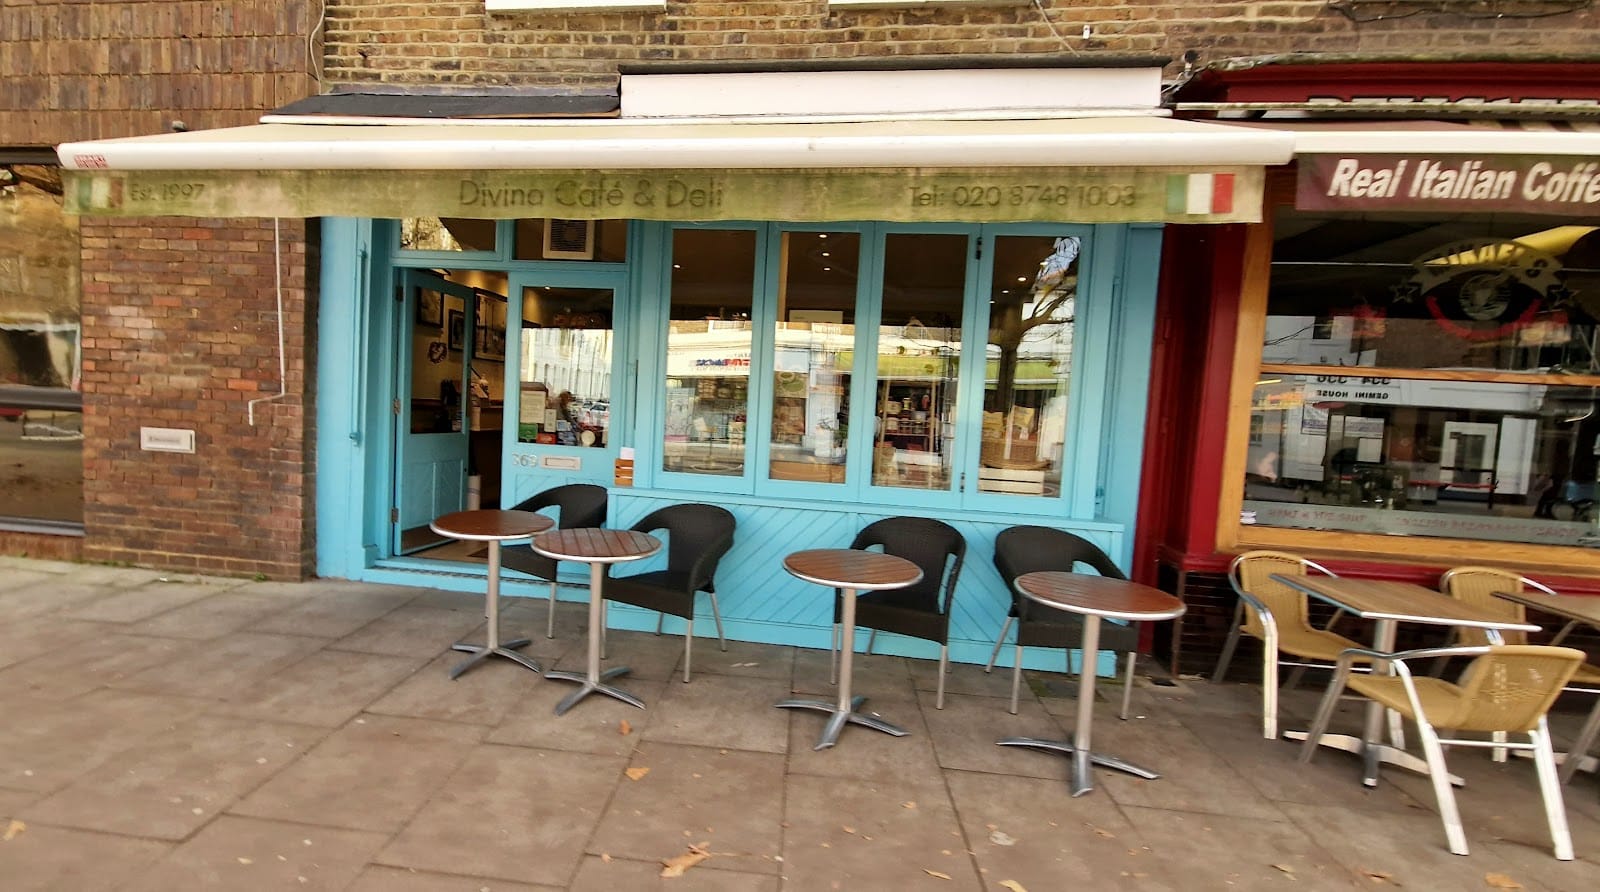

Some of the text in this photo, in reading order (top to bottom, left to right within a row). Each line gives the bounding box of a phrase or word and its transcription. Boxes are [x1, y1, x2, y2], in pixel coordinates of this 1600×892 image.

[162, 183, 205, 201] 1997
[1327, 158, 1408, 198] Real
[1408, 160, 1517, 199] Italian
[458, 177, 724, 208] Divina Café & Deli
[909, 184, 1137, 208] Tel: 020 8748 1003
